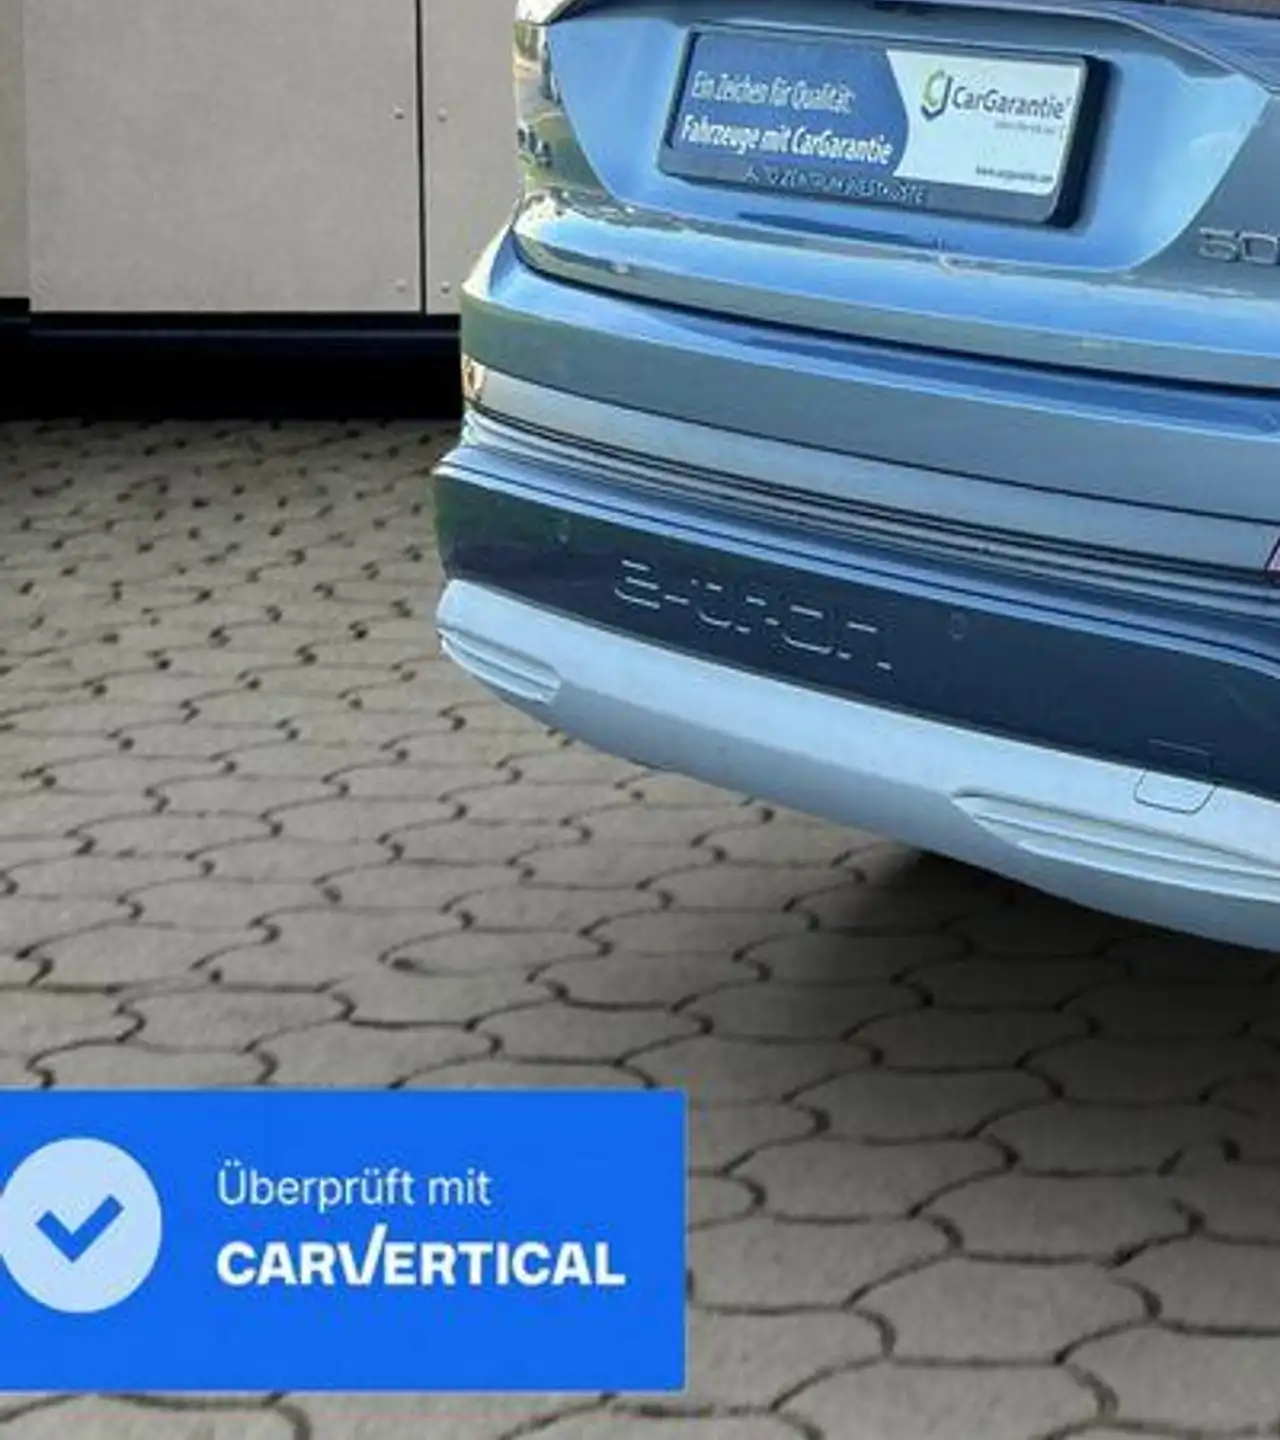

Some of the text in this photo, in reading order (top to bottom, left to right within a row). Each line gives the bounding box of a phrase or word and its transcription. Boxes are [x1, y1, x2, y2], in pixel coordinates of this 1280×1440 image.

[682, 114, 893, 164] Fahrzeuge mit CarGarantie
